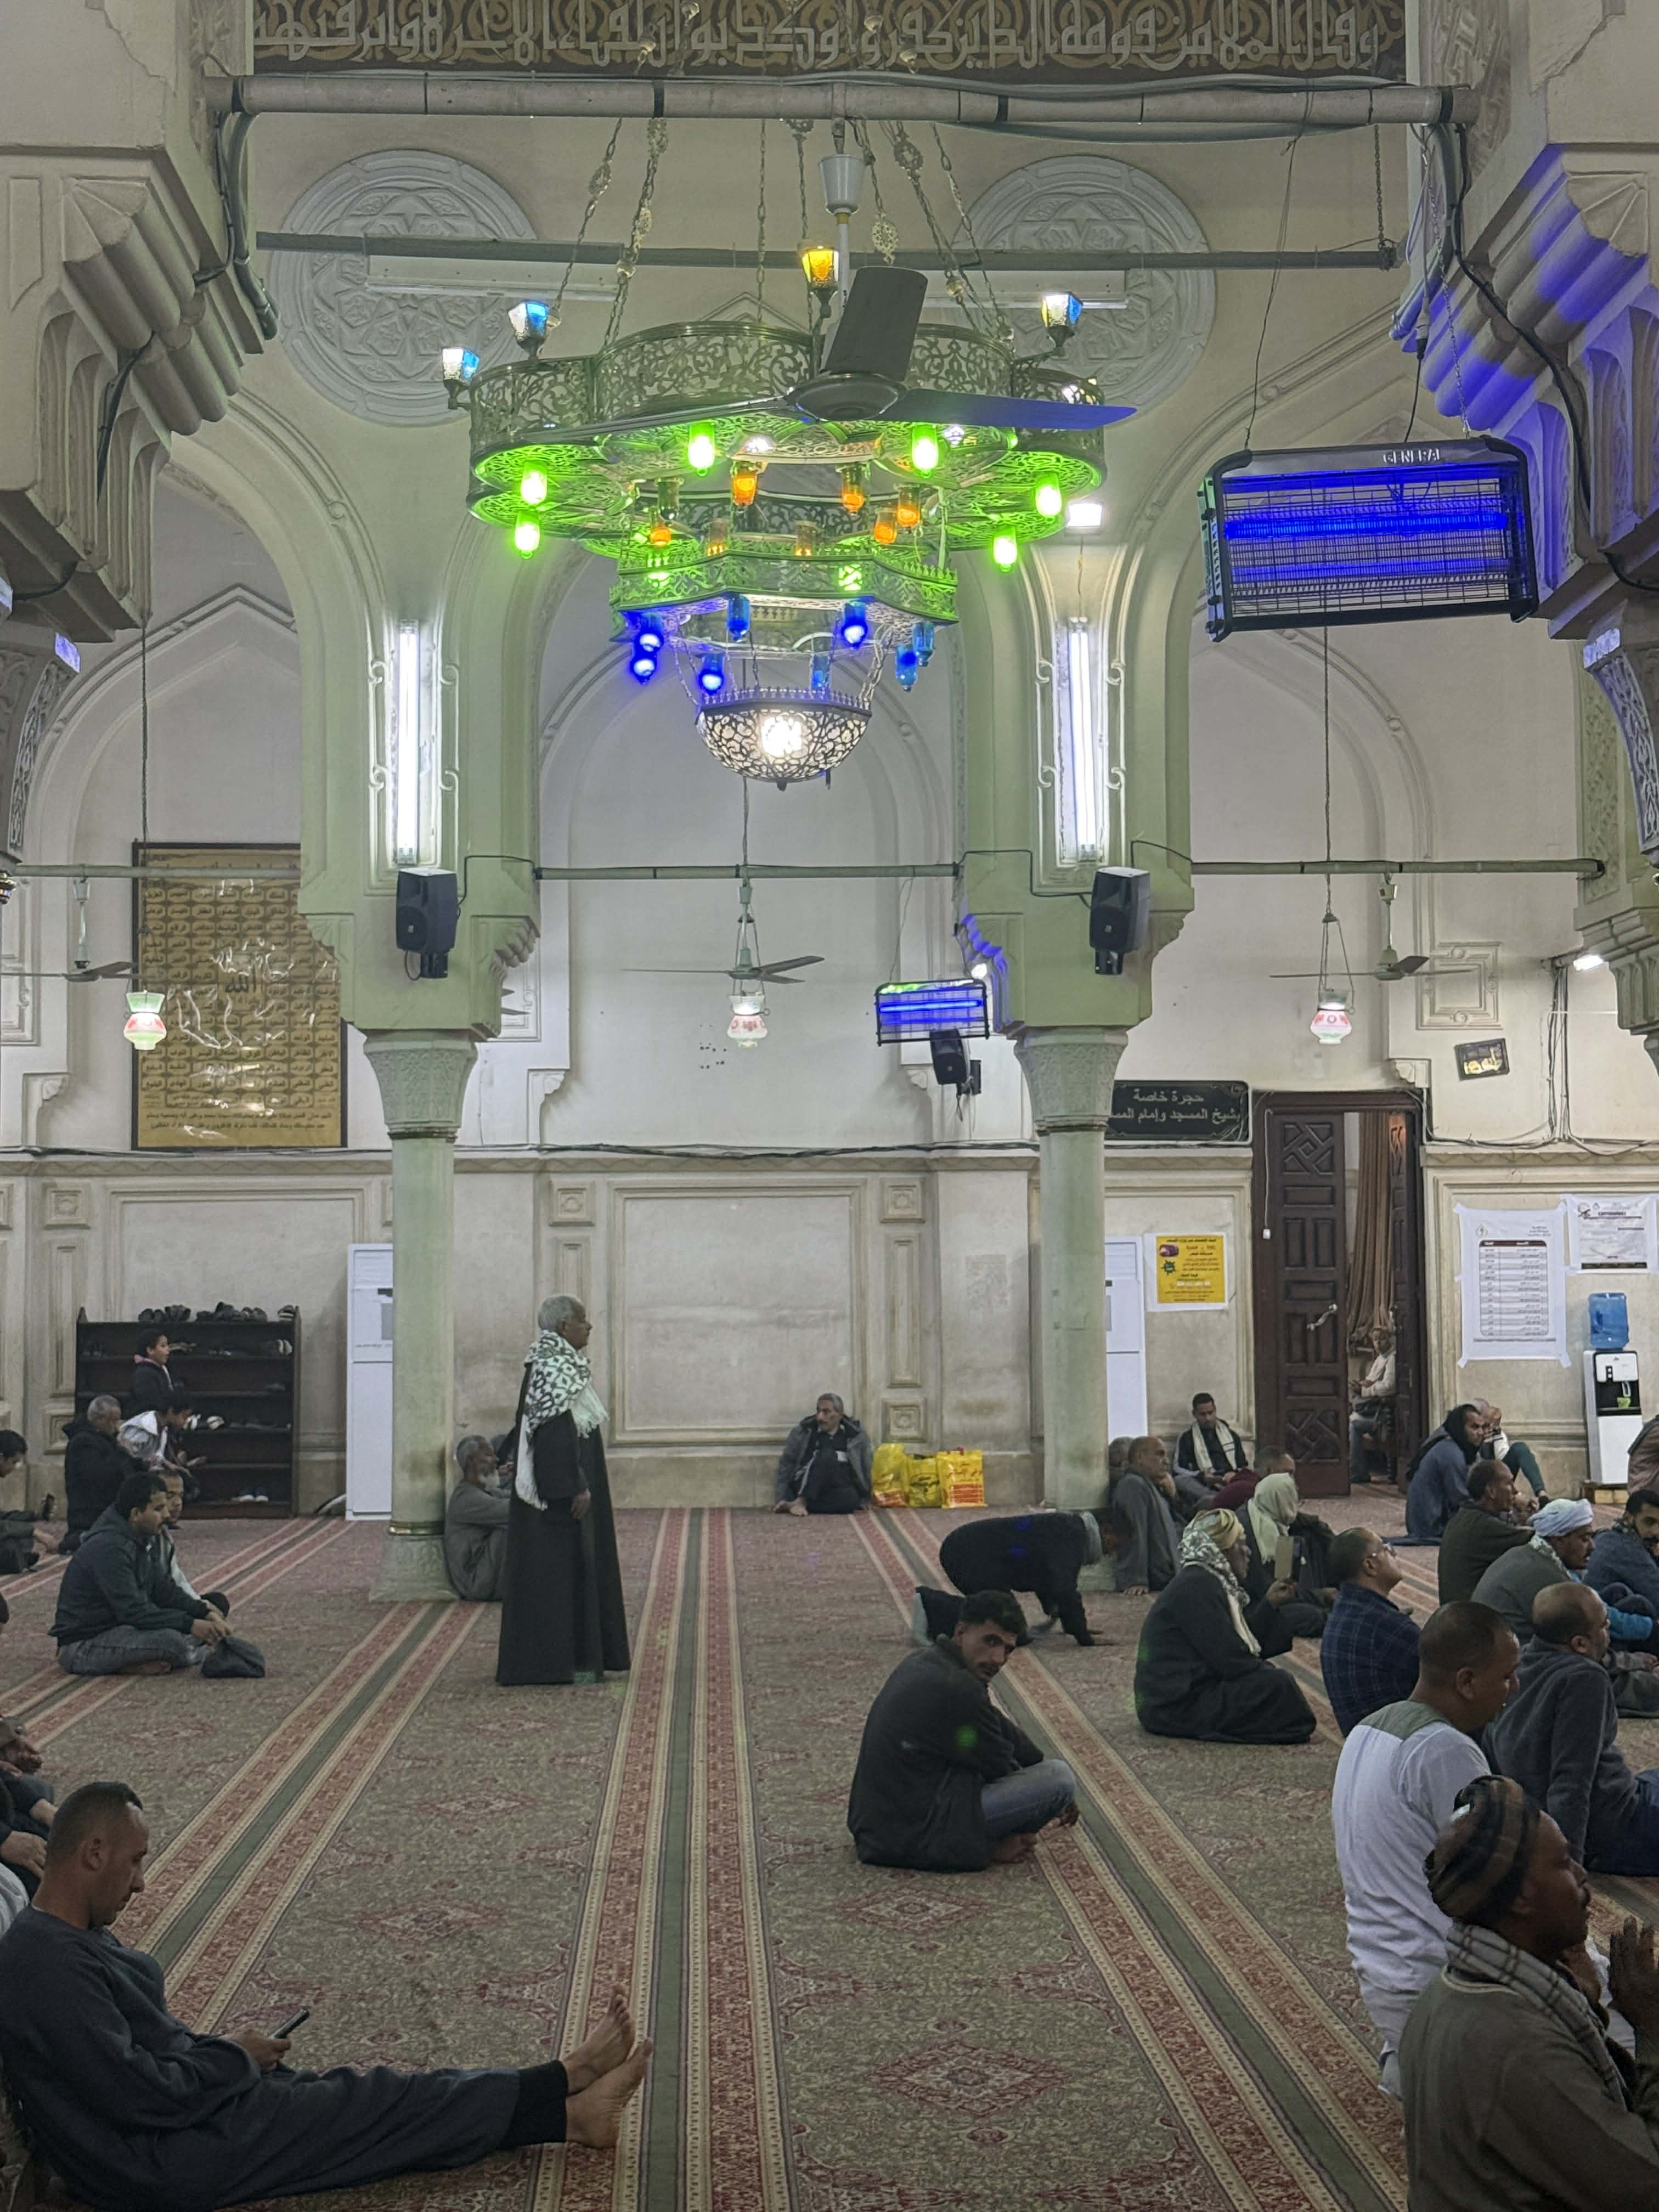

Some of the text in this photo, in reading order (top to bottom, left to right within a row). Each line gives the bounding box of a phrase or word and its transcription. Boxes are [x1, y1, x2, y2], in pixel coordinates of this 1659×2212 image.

[1138, 15, 1212, 71] من
[1383, 447, 1441, 465] GENERAL
[225, 973, 256, 993] الله
[1133, 1088, 1204, 1105] حجرة خاصة
[1137, 1108, 1166, 1124] وإمام
[1170, 1108, 1207, 1122] المسجد
